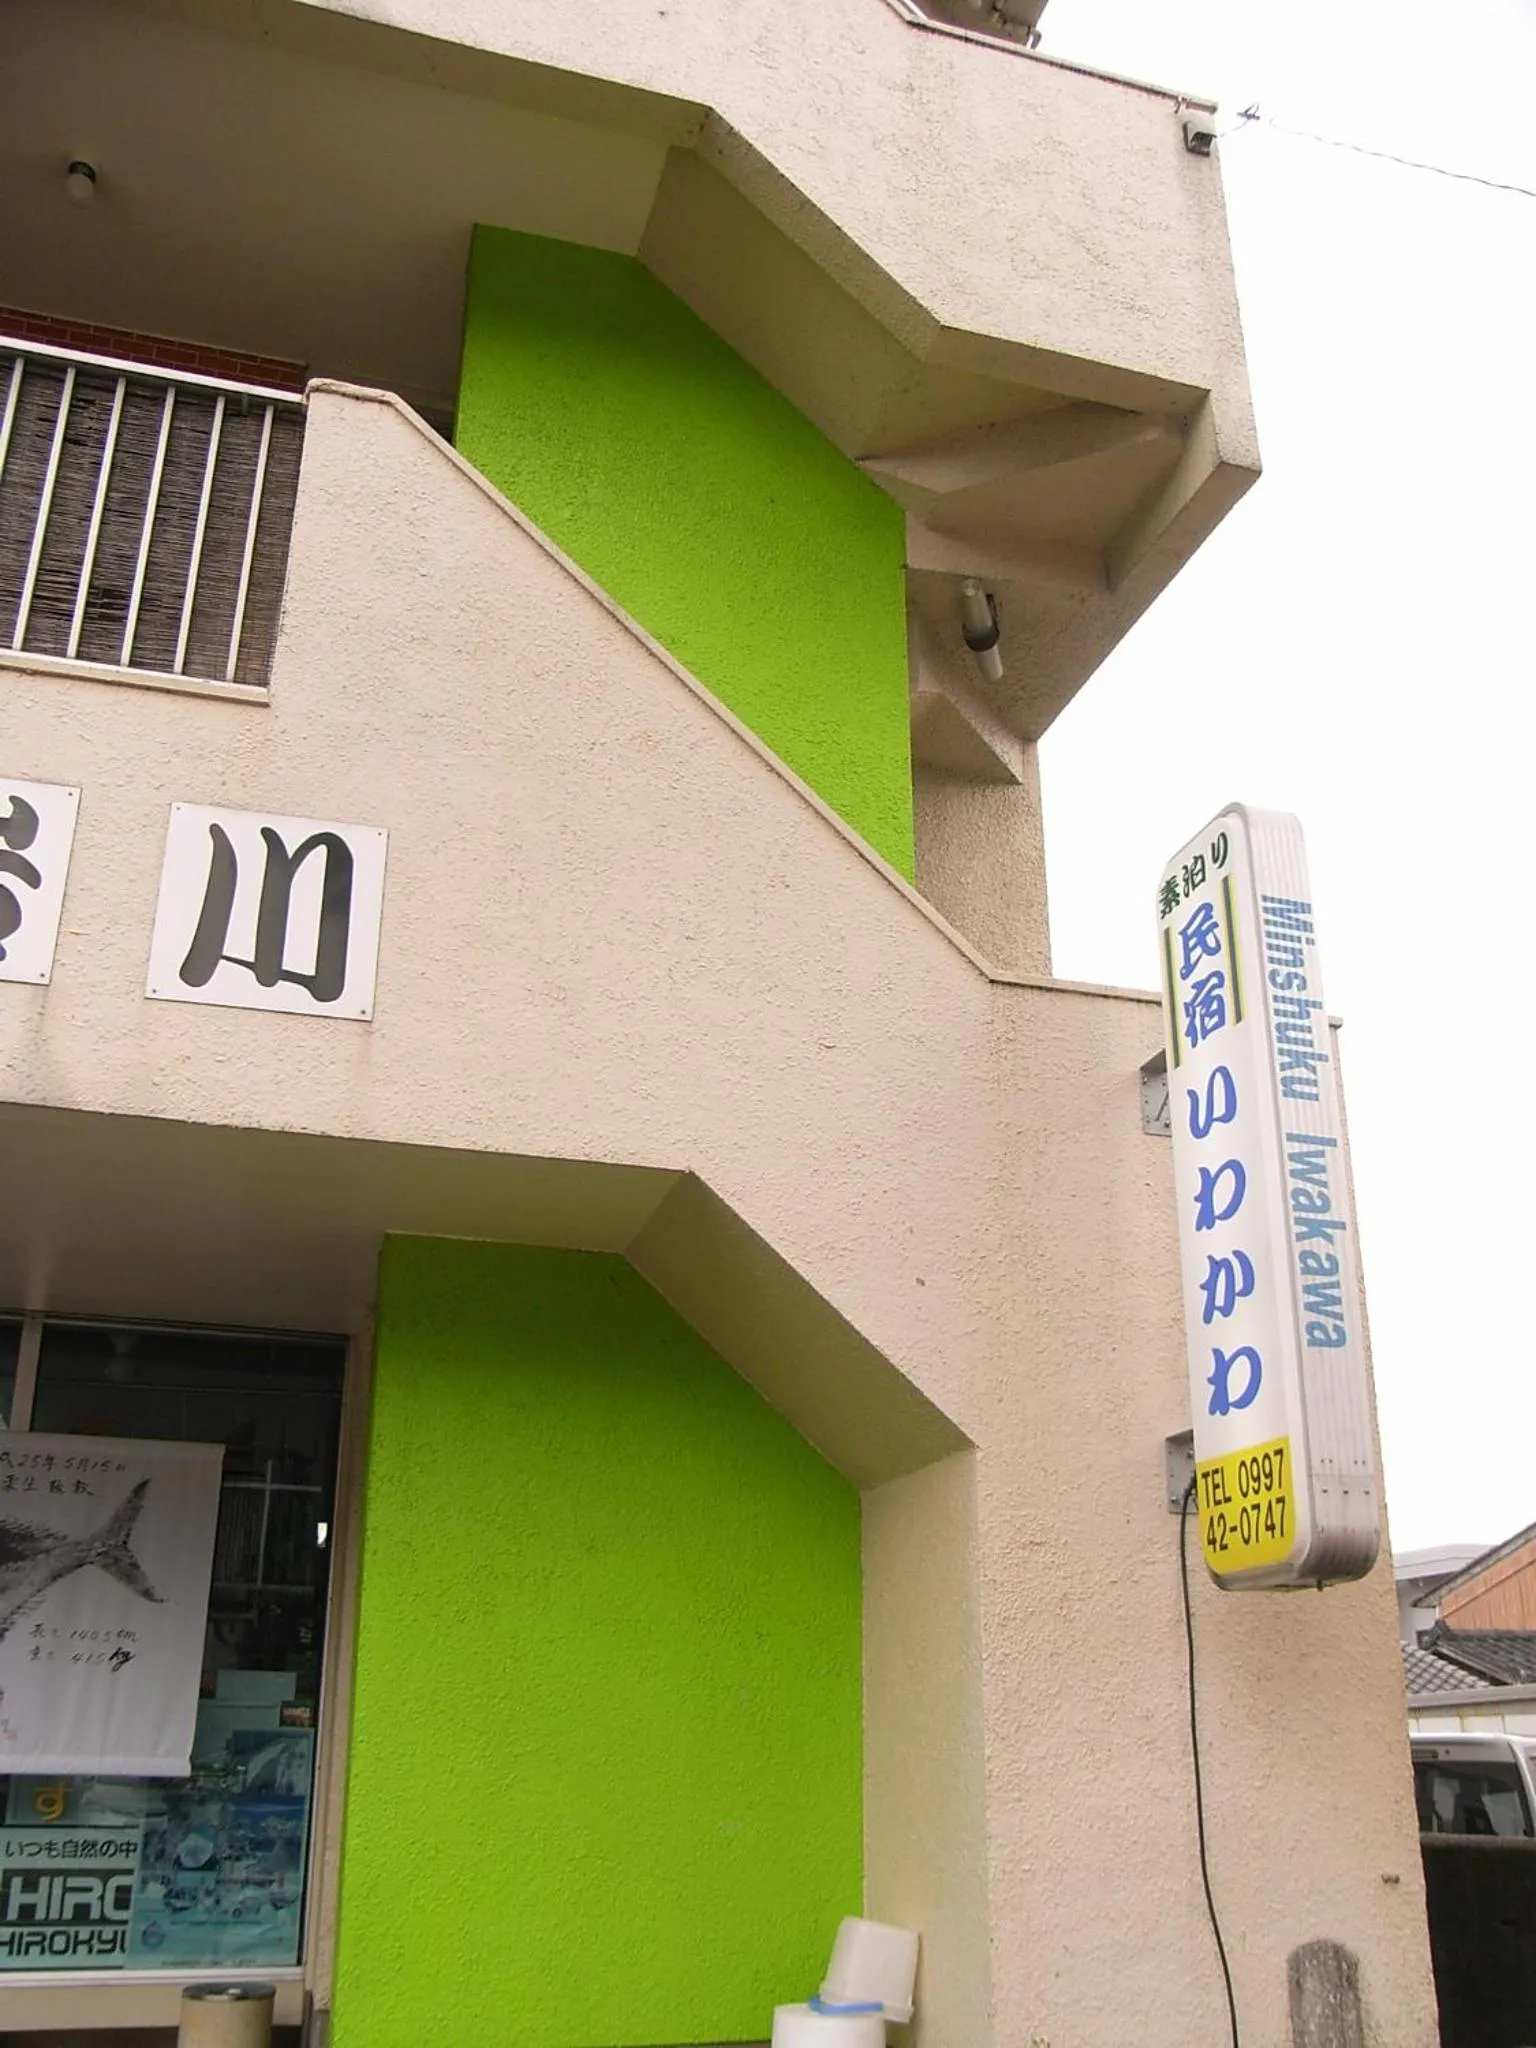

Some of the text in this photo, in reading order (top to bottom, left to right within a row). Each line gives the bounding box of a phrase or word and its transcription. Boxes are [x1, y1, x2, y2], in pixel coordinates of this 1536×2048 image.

[179, 822, 354, 1003] 川
[1158, 831, 1230, 920] 素泊り
[1179, 901, 1263, 1417] 民宿 いわかわ
[1261, 894, 1347, 1349] Minshuku Iwakawa
[1201, 1448, 1285, 1510] TEL 0997
[1206, 1496, 1288, 1555] 42-0747
[5, 1839, 138, 1860] いつも自然の中
